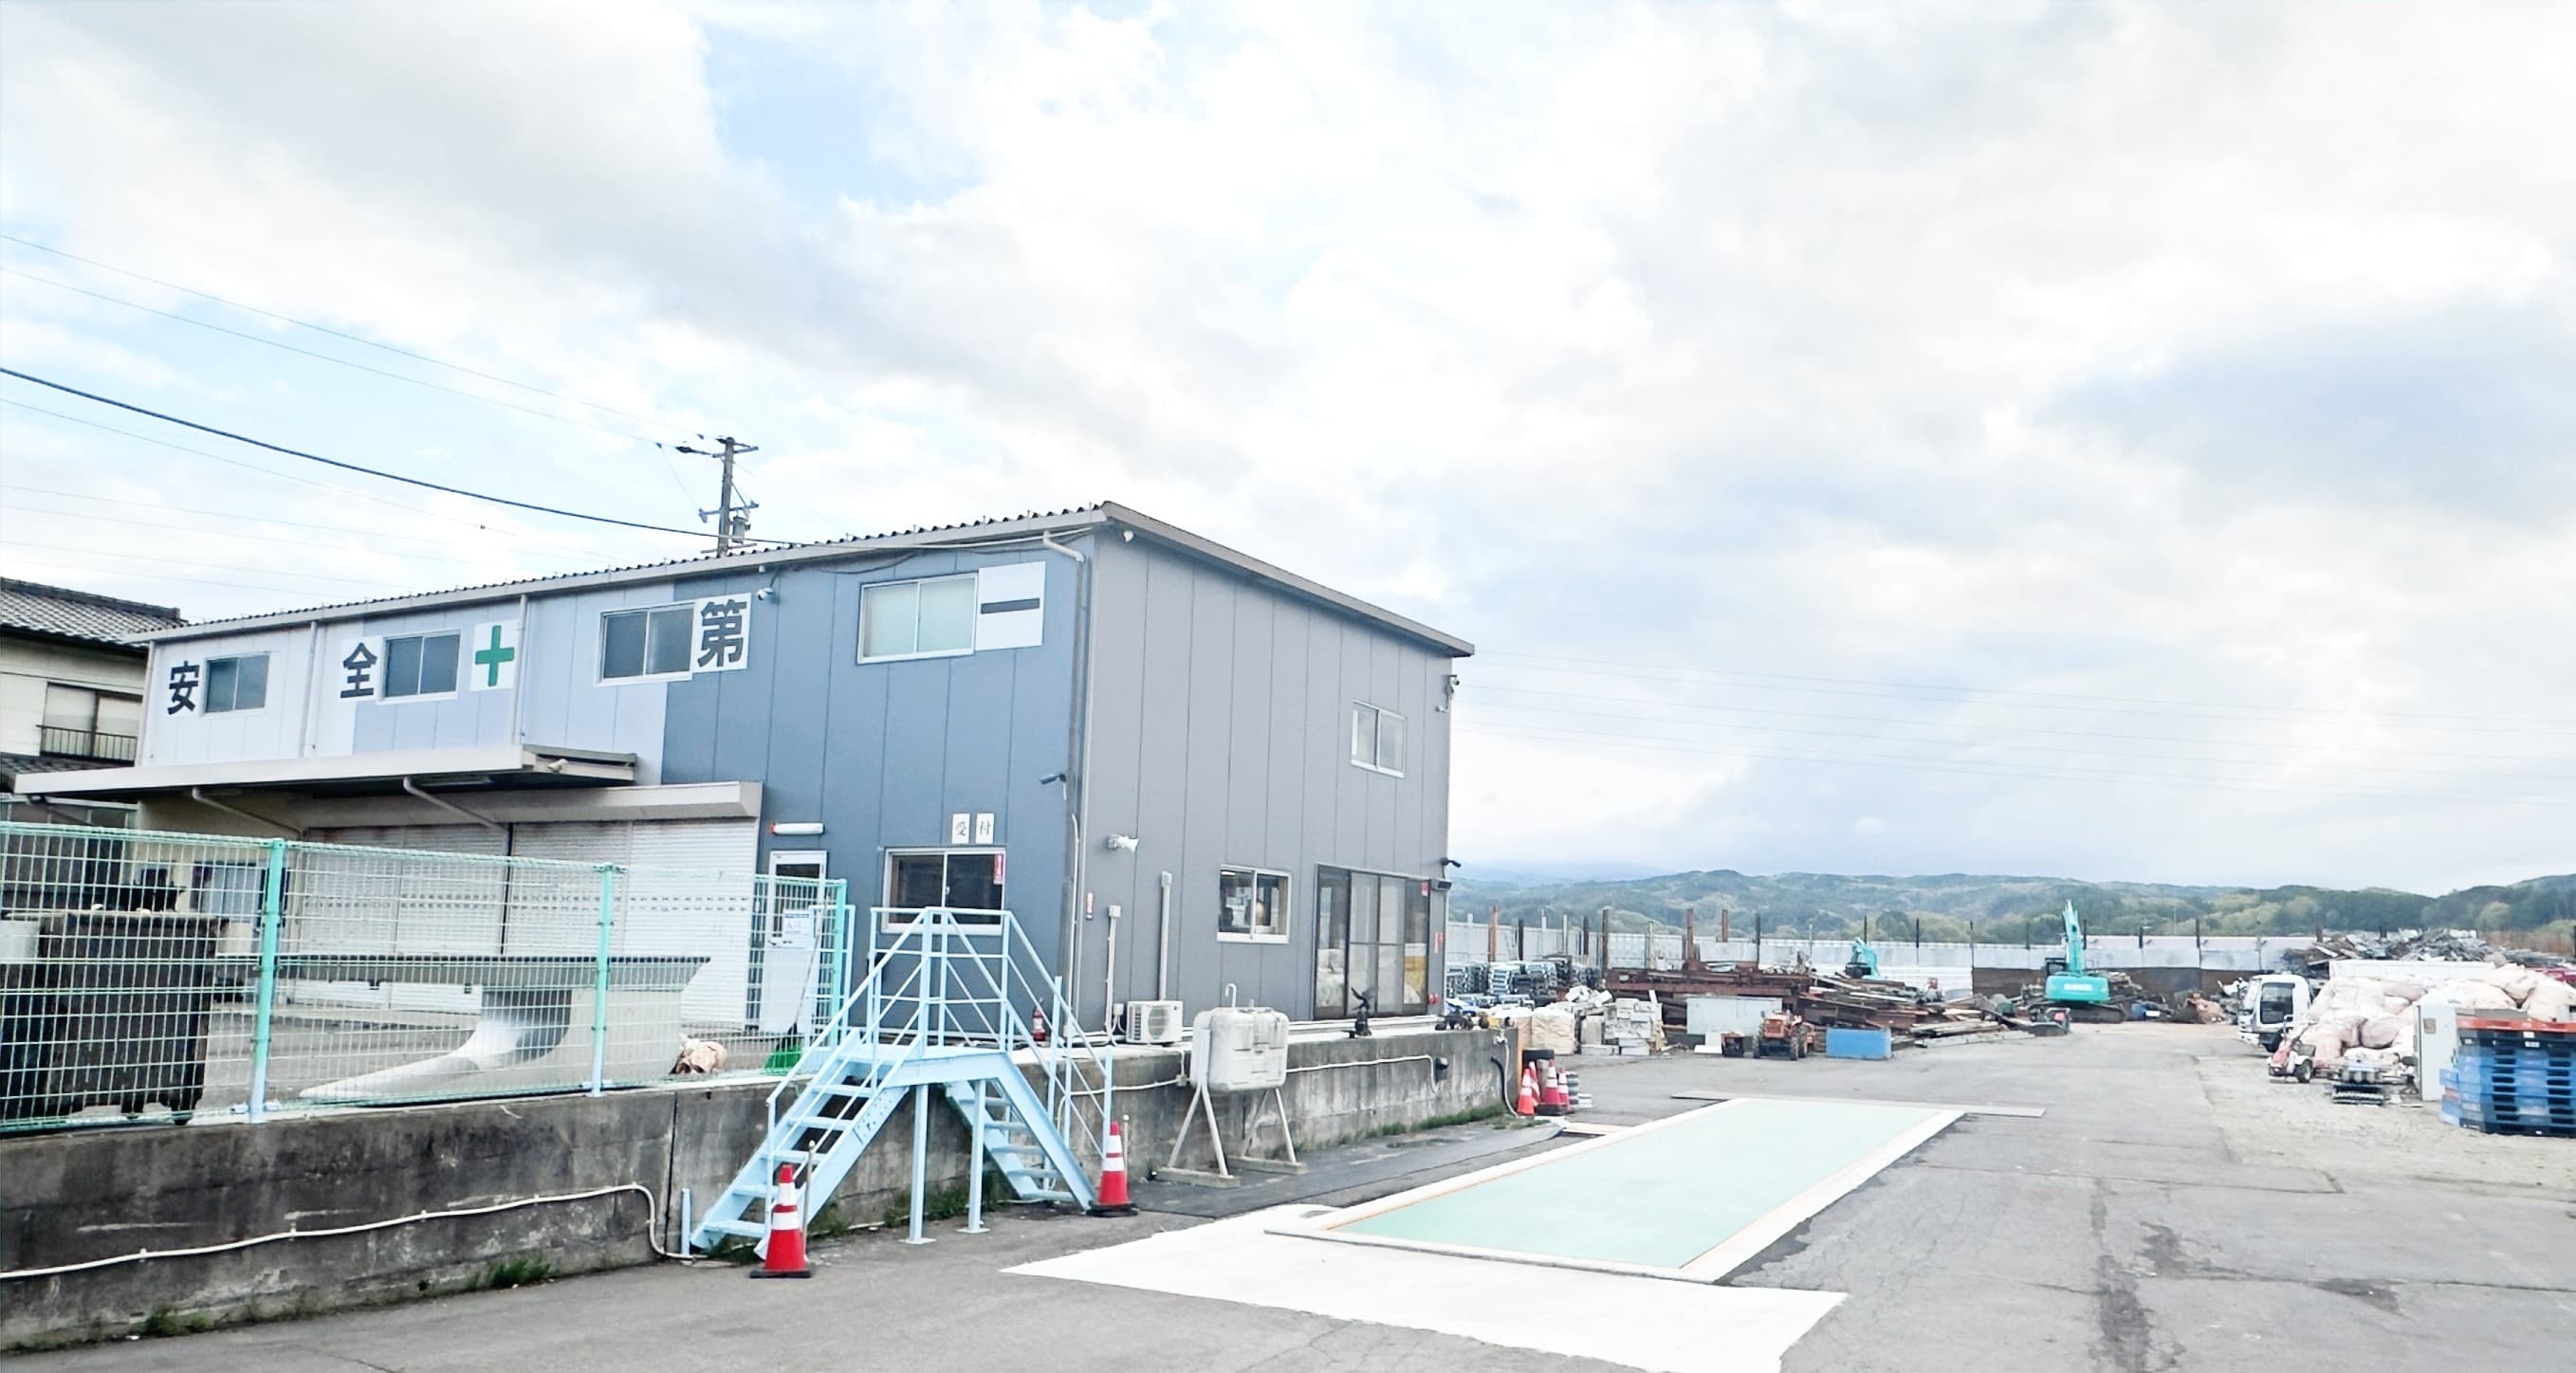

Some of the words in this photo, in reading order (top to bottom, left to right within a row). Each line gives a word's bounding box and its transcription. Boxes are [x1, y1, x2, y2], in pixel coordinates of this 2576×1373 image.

[167, 660, 200, 715] 安
[340, 642, 377, 699] 全
[697, 598, 747, 668] 第
[980, 597, 1040, 614] 一
